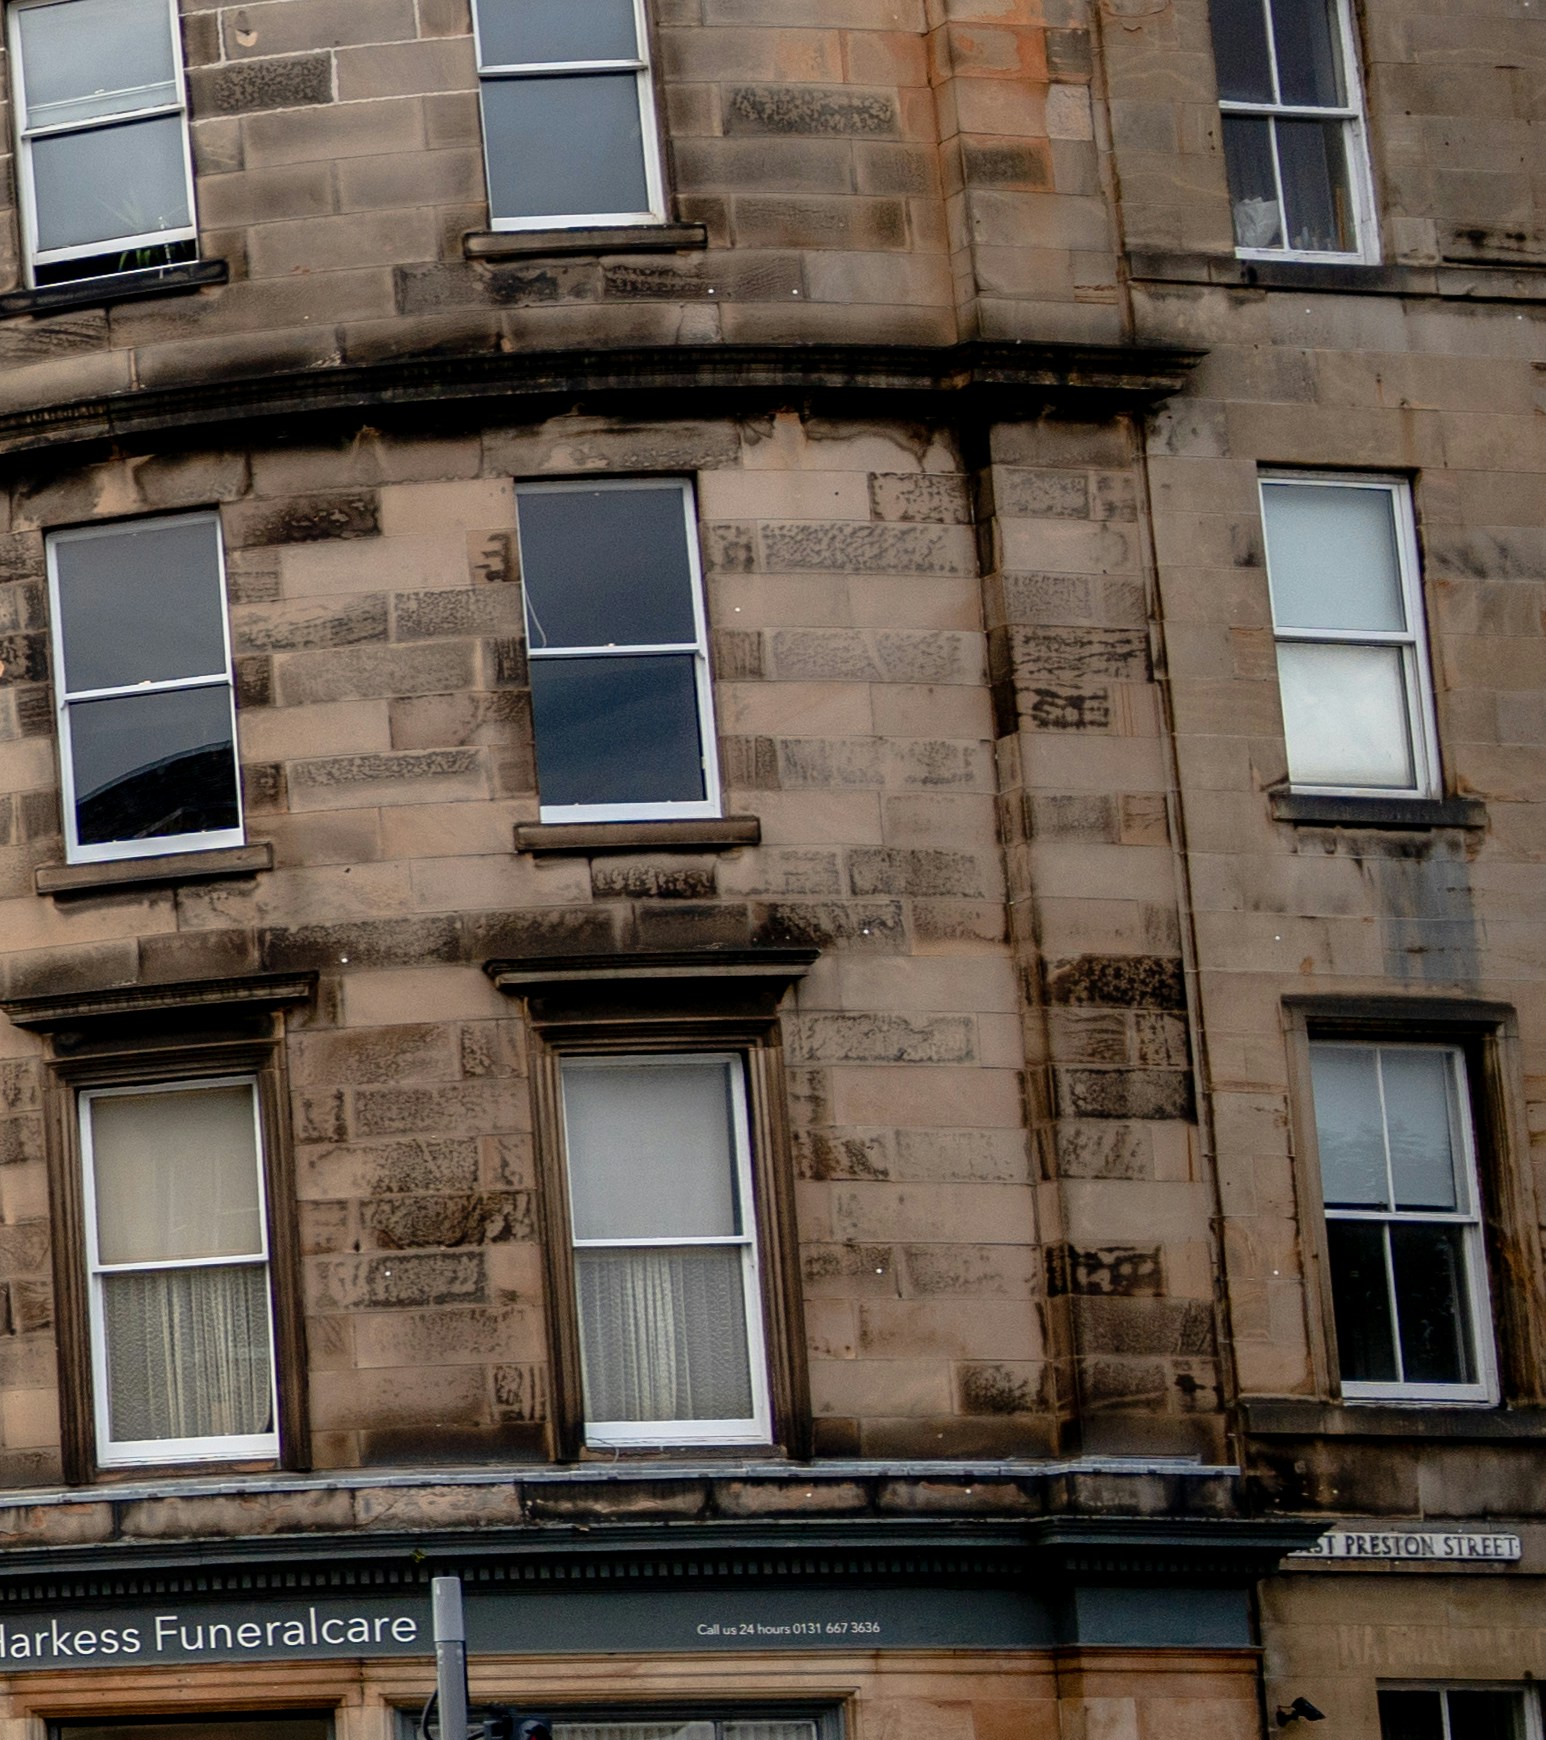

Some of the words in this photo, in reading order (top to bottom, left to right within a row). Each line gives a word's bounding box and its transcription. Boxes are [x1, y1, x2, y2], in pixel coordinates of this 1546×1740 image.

[1346, 1535, 1435, 1556] PRESTON
[1443, 1536, 1516, 1557] STREET
[155, 1607, 418, 1651] Funeralcare
[697, 1623, 720, 1635] Call
[723, 1627, 737, 1635] us
[739, 1624, 755, 1635] 24
[757, 1623, 790, 1635] hours
[792, 1623, 822, 1634] 0131
[826, 1623, 848, 1634] 667
[851, 1622, 880, 1633] 3636
